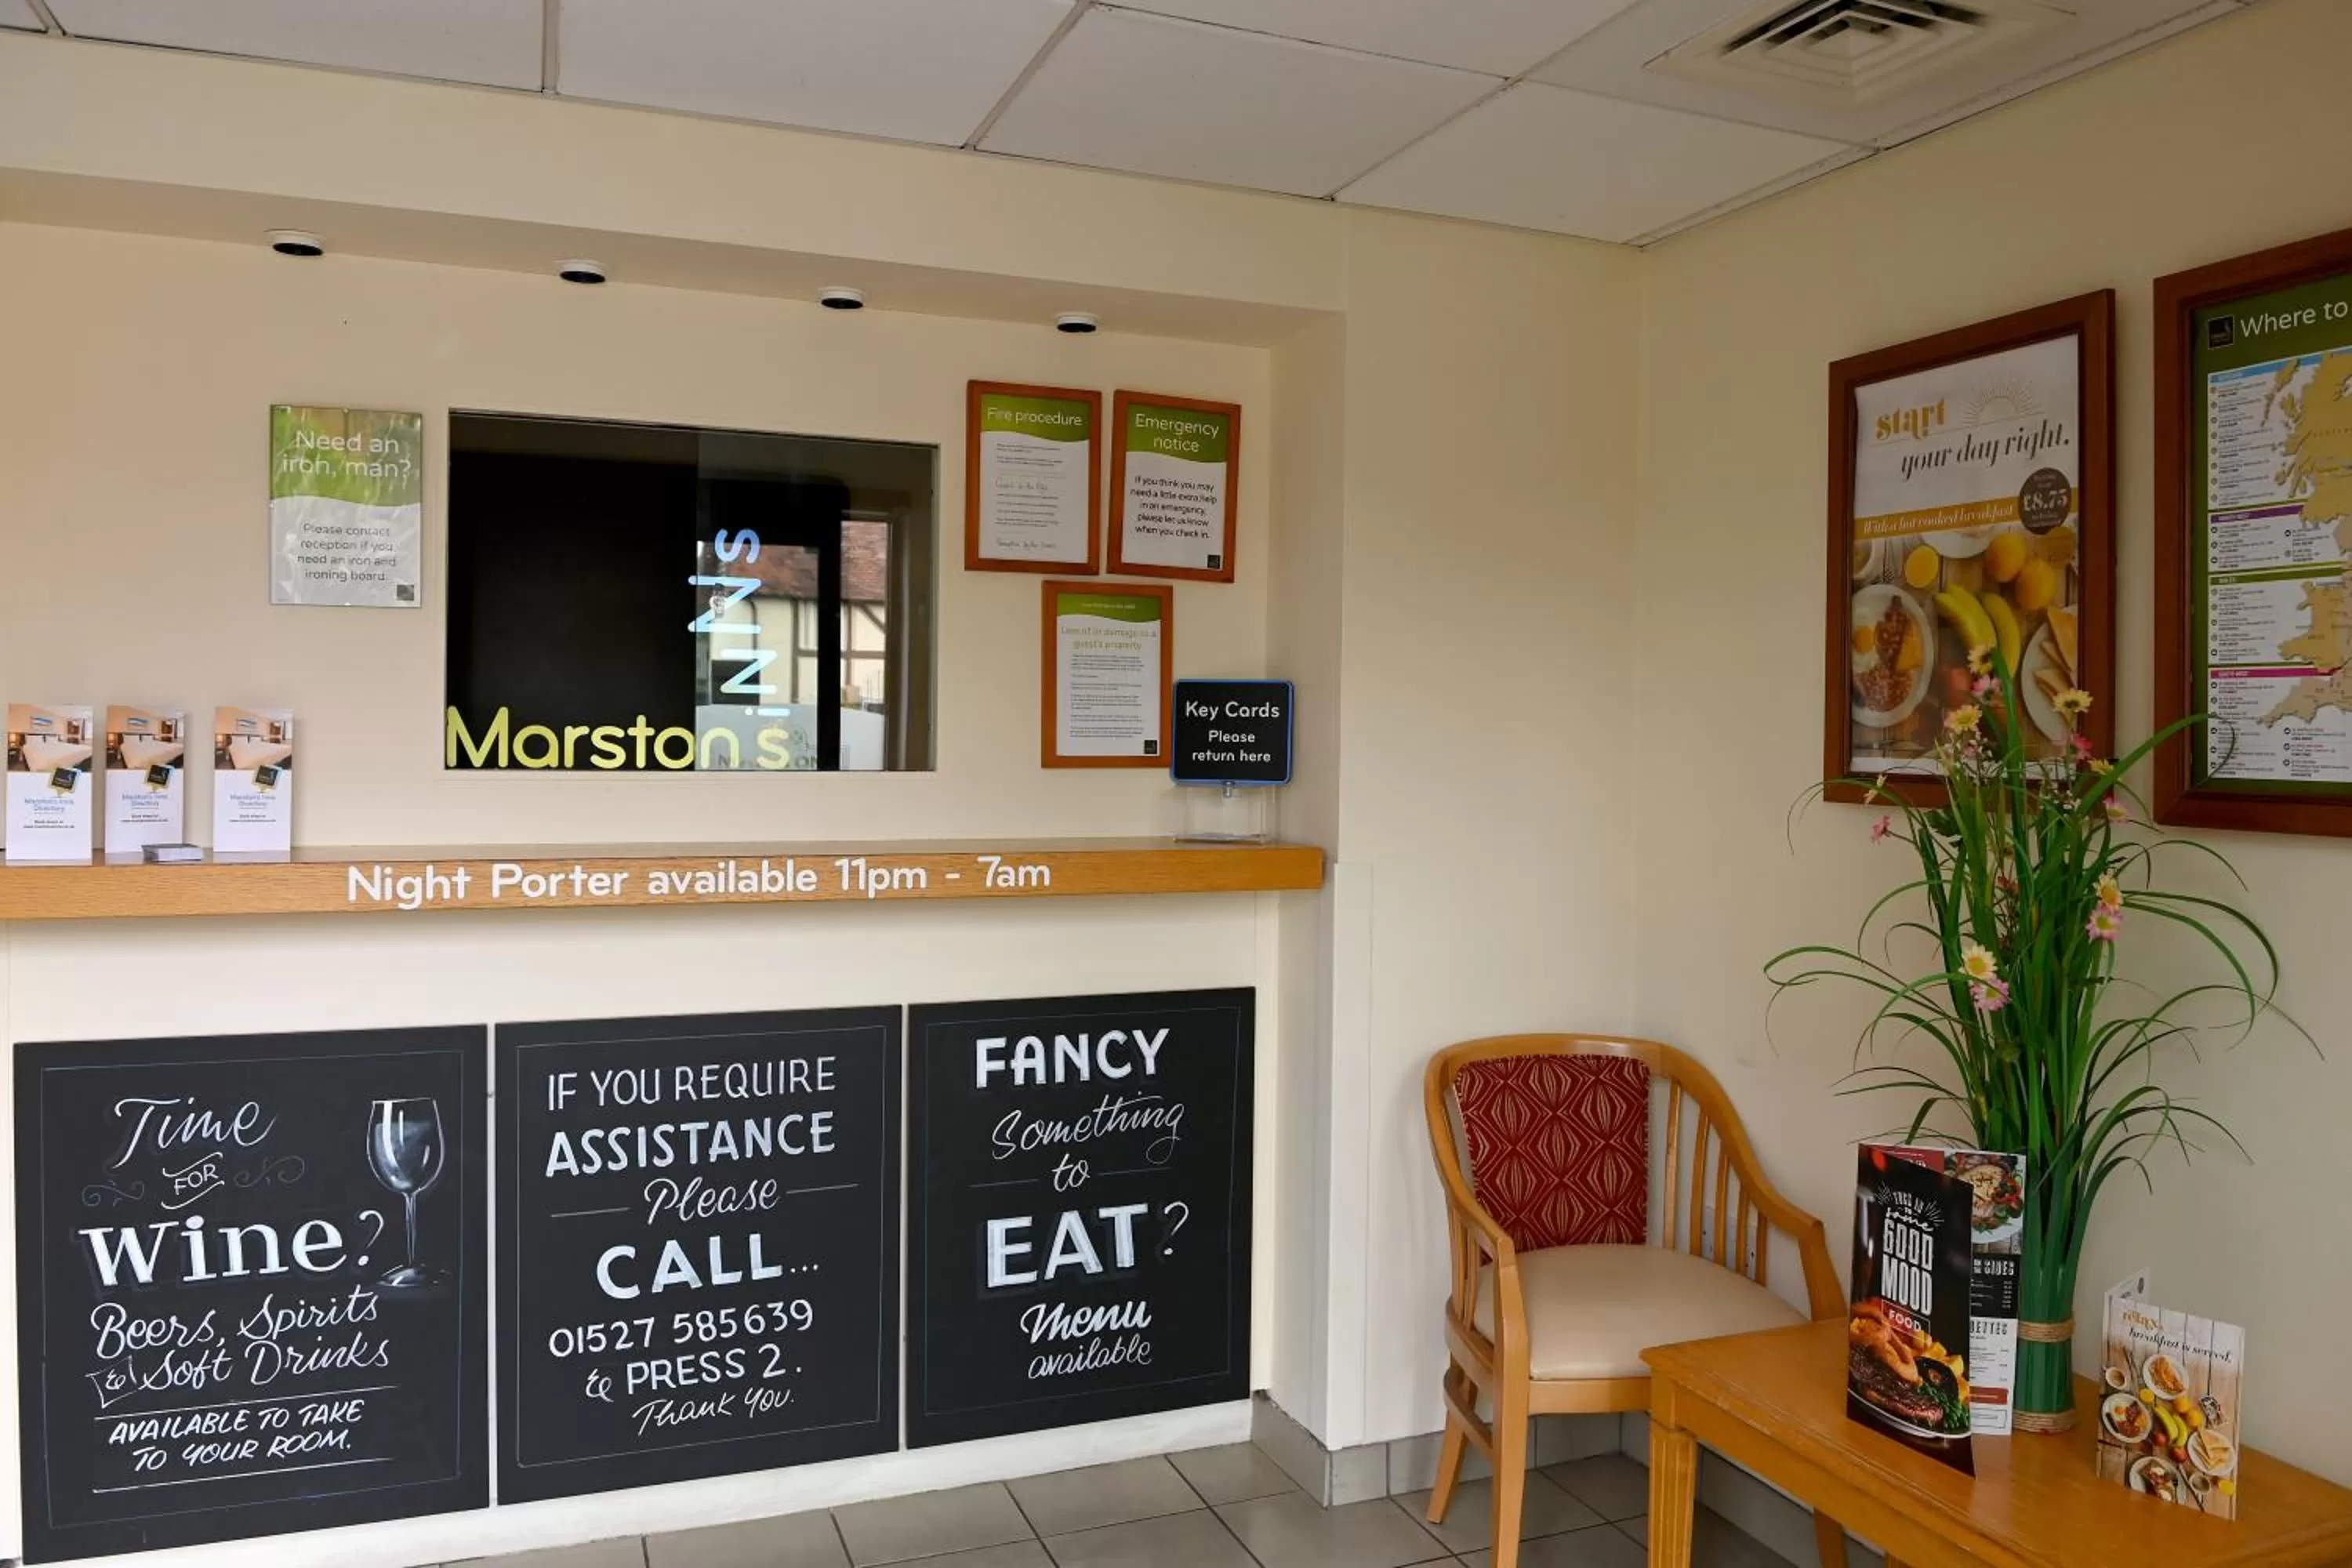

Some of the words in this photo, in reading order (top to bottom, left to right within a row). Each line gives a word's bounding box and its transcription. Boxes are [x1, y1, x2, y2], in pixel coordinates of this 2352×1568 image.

[2241, 307, 2316, 338] Where
[2324, 301, 2348, 320] to
[987, 407, 1012, 421] Fire
[1015, 411, 1083, 426] procedure
[1136, 413, 1219, 439] Emergency
[1876, 398, 1945, 440] start
[295, 430, 361, 452] Need
[369, 437, 399, 453] an
[1153, 436, 1200, 452] notice
[1901, 447, 1951, 481] your
[1957, 434, 1998, 466] day
[2005, 419, 2070, 460] right.
[282, 453, 336, 477] iron,
[1143, 477, 1158, 488] you
[1159, 477, 1178, 487] think
[1181, 481, 1196, 490] you
[1196, 484, 1214, 493] may
[1130, 488, 1151, 498] need
[1160, 490, 1177, 499] little
[1200, 494, 1218, 505] help
[303, 523, 343, 534] Please
[346, 526, 390, 536] contact
[1134, 525, 1158, 535] when
[1159, 528, 1174, 537] you
[1176, 529, 1198, 538] check
[1138, 514, 1163, 524] please
[1165, 514, 1176, 524] let
[1187, 517, 1209, 527] know
[297, 554, 328, 564] need
[348, 555, 372, 564] iron
[374, 557, 397, 567] and
[300, 539, 358, 551] reception
[360, 539, 369, 549] if
[370, 542, 394, 553] you
[304, 568, 348, 582] ironing
[1185, 699, 1219, 721] Key
[1225, 700, 1281, 718] Cards
[1192, 749, 1236, 761] return
[1240, 749, 1272, 763] here
[1208, 730, 1256, 743] Please
[347, 863, 472, 911] Night
[491, 862, 630, 898] Porter
[648, 858, 818, 895] available
[834, 857, 927, 899] 11pm
[977, 855, 1051, 887] 7am
[976, 1028, 1171, 1089] FANCY
[548, 1071, 578, 1112] IF
[590, 1068, 661, 1107] YOU
[674, 1055, 837, 1102] REQUIRE
[112, 1096, 278, 1170] Time
[545, 1110, 836, 1178] ASSISTANCE
[991, 1091, 1185, 1164] Something
[173, 1163, 218, 1196] FOR
[1051, 1153, 1091, 1192] to
[644, 1176, 782, 1226] Please
[78, 1209, 385, 1287] Wine?
[1882, 1218, 1934, 1272] GOOD
[1882, 1253, 1933, 1316] MOOD
[90, 1301, 225, 1359] Beers,
[237, 1284, 379, 1341] Spirits
[548, 1316, 655, 1358] 01527
[673, 1298, 814, 1344] 585639
[1020, 1299, 1152, 1344] Menu
[1889, 1309, 1922, 1331] FOOD
[137, 1347, 234, 1390] Soft
[243, 1330, 390, 1385] Drinks
[626, 1347, 746, 1396] PRESS
[1028, 1332, 1152, 1380] available
[108, 1408, 250, 1445] AVAILABLE
[258, 1406, 289, 1431] TO
[299, 1399, 365, 1428] TAKE
[632, 1392, 739, 1436] Thank
[132, 1449, 168, 1472] TO
[180, 1439, 260, 1468] YOUR
[267, 1428, 352, 1459] ROOM.
